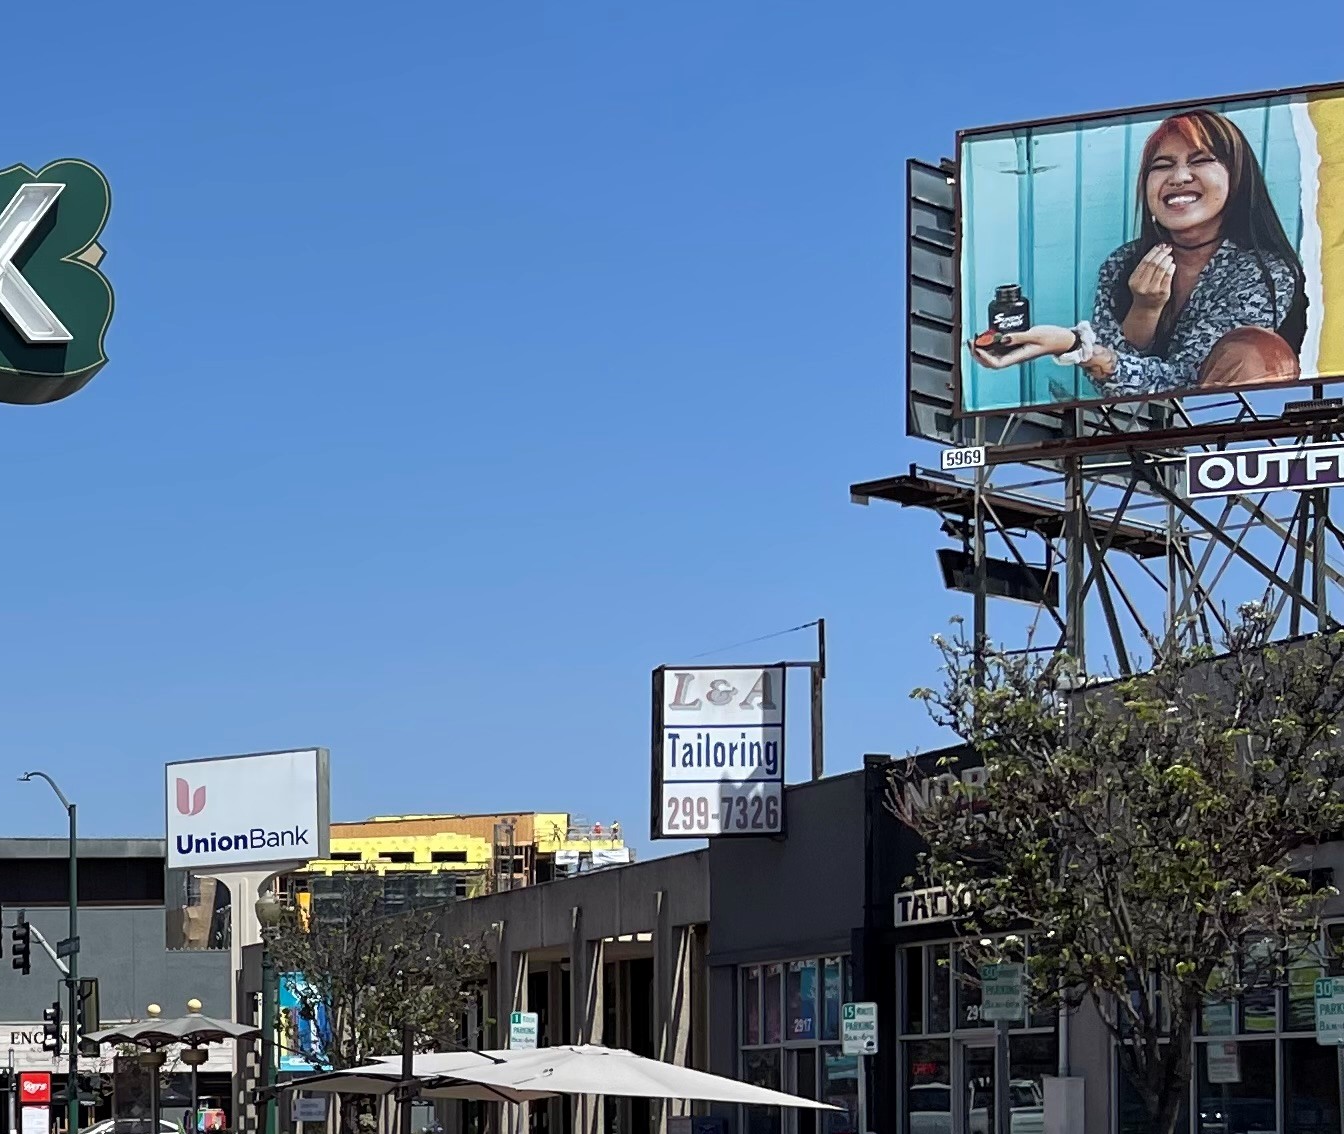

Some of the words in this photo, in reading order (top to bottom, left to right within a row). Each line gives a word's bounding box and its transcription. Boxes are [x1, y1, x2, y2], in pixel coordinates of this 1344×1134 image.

[946, 450, 981, 466] 5969
[1198, 450, 1344, 490] OUTF
[668, 672, 702, 711] L
[706, 678, 738, 706] &
[738, 670, 777, 711] A
[667, 732, 778, 775] Tailoring
[667, 795, 779, 831] 299-7326
[176, 825, 309, 855] UnionBank
[1316, 981, 1331, 996] 30
[844, 1005, 854, 1017] 15
